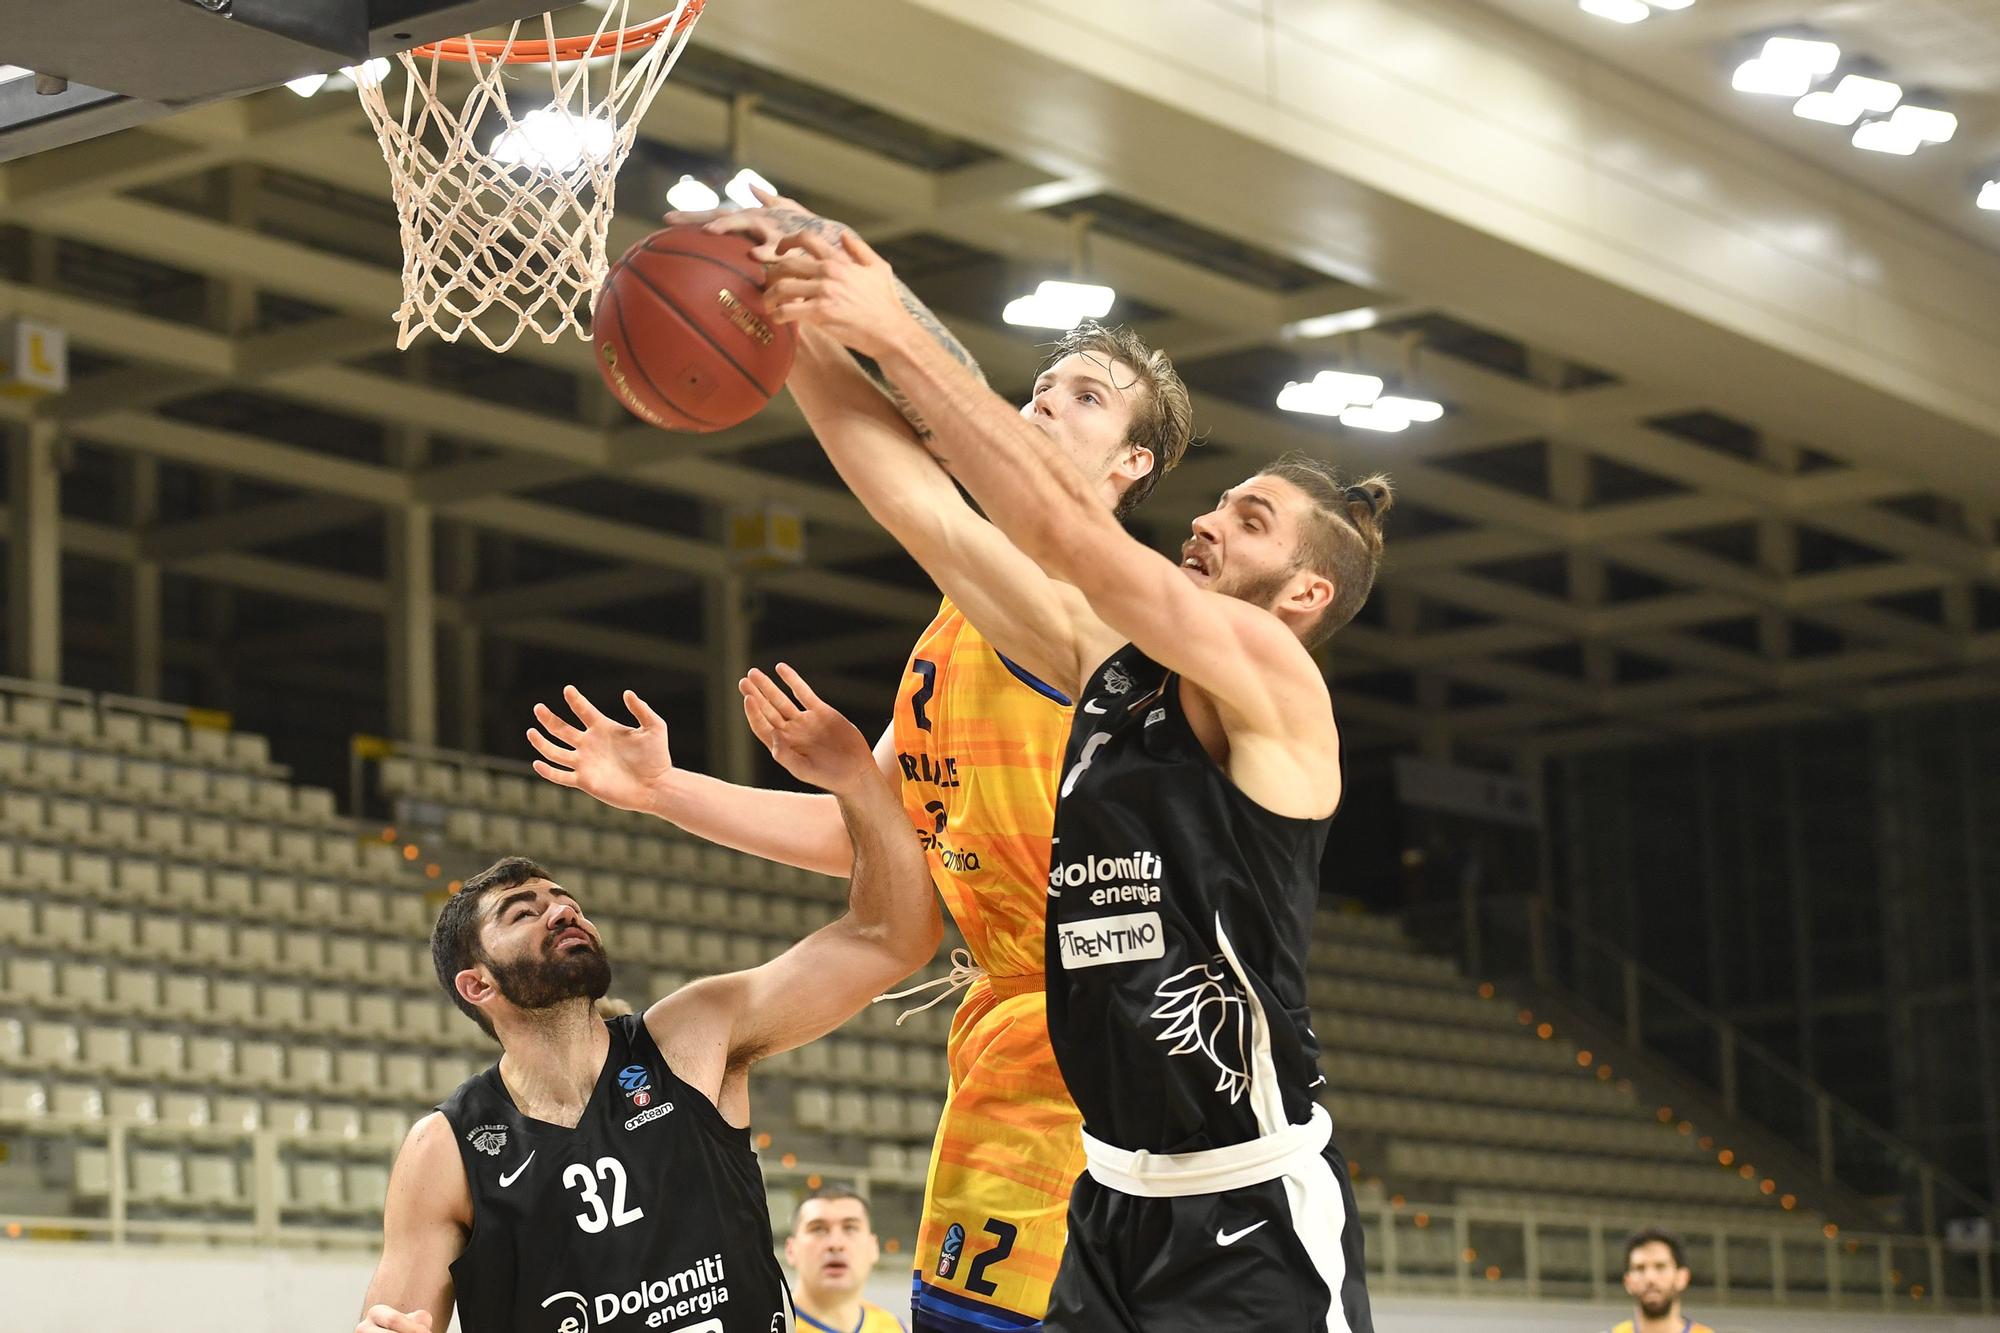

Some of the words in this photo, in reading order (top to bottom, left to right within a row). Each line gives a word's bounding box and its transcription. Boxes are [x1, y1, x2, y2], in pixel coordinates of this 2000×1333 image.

[1089, 883, 1161, 905] energia
[1065, 923, 1155, 957] TRENTINO
[625, 1103, 673, 1130] oneteam
[562, 1156, 644, 1234] 32
[965, 1217, 1018, 1297] 2
[595, 1253, 725, 1326] Dolomiti
[645, 1286, 730, 1329] energia
